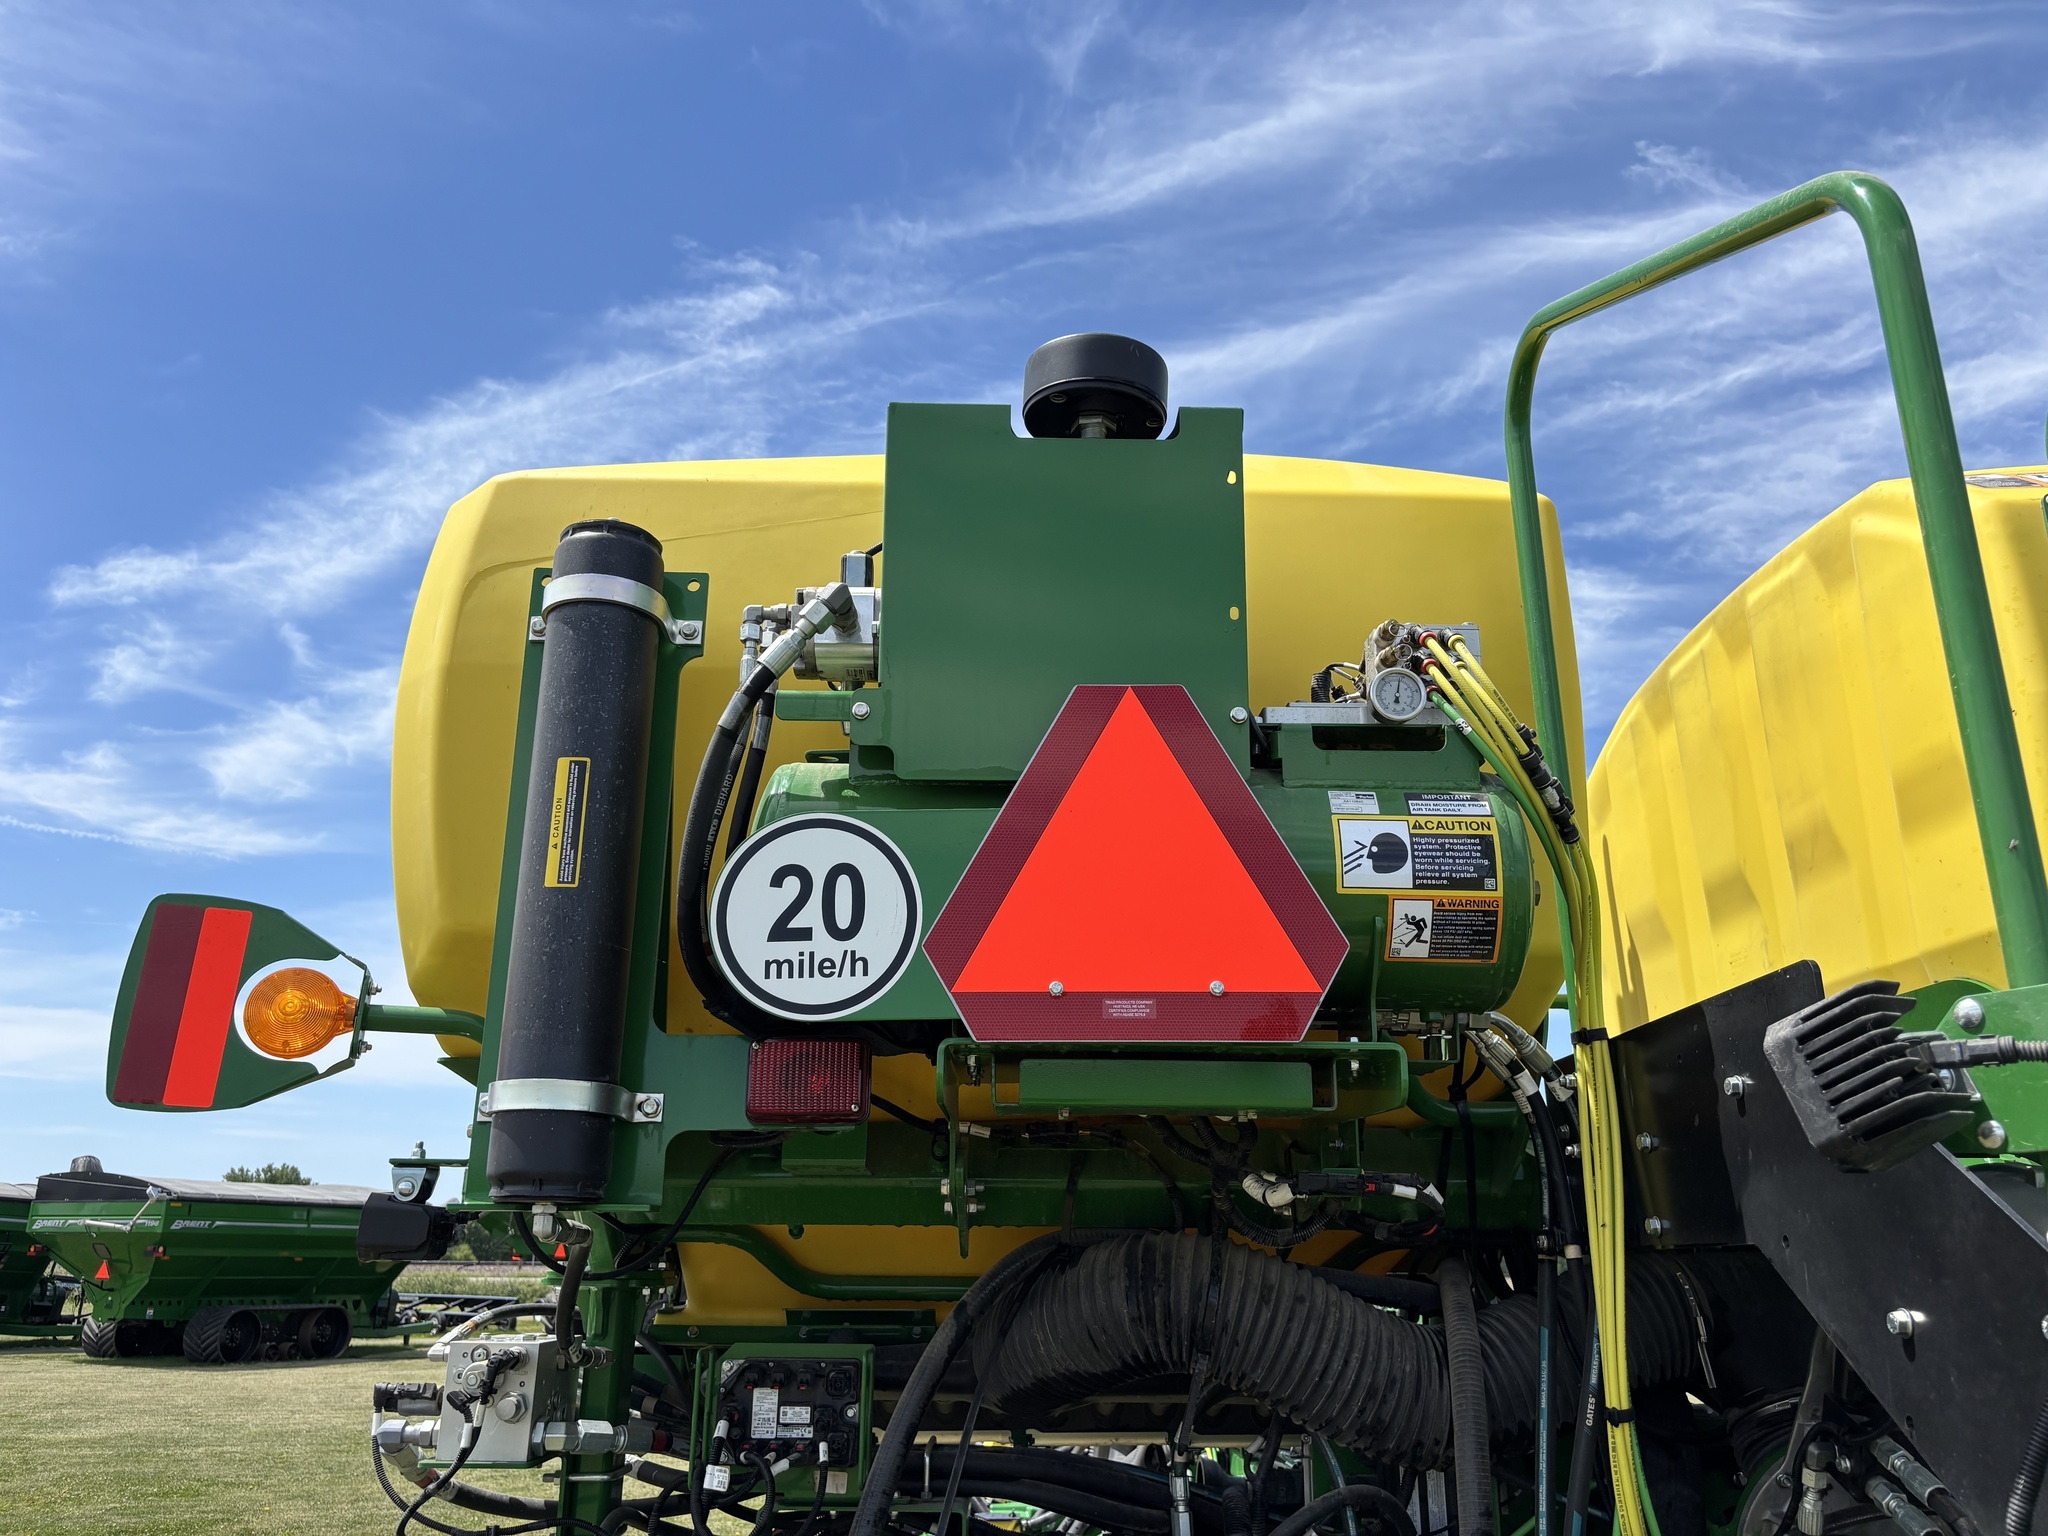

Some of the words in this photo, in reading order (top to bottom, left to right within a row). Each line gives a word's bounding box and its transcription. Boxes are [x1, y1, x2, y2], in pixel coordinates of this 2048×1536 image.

[1456, 721, 1469, 732] S3
[714, 774, 734, 816] DIEHARD
[552, 797, 562, 838] CAUTION
[1424, 820, 1491, 831] CAUTION
[1440, 864, 1474, 872] servicing
[767, 862, 866, 942] 20
[1447, 899, 1500, 909] WARNING
[764, 950, 869, 980] mile/h
[32, 1219, 65, 1229] BRENT
[170, 1220, 212, 1230] BRENT
[1585, 1397, 1596, 1426] GATES
